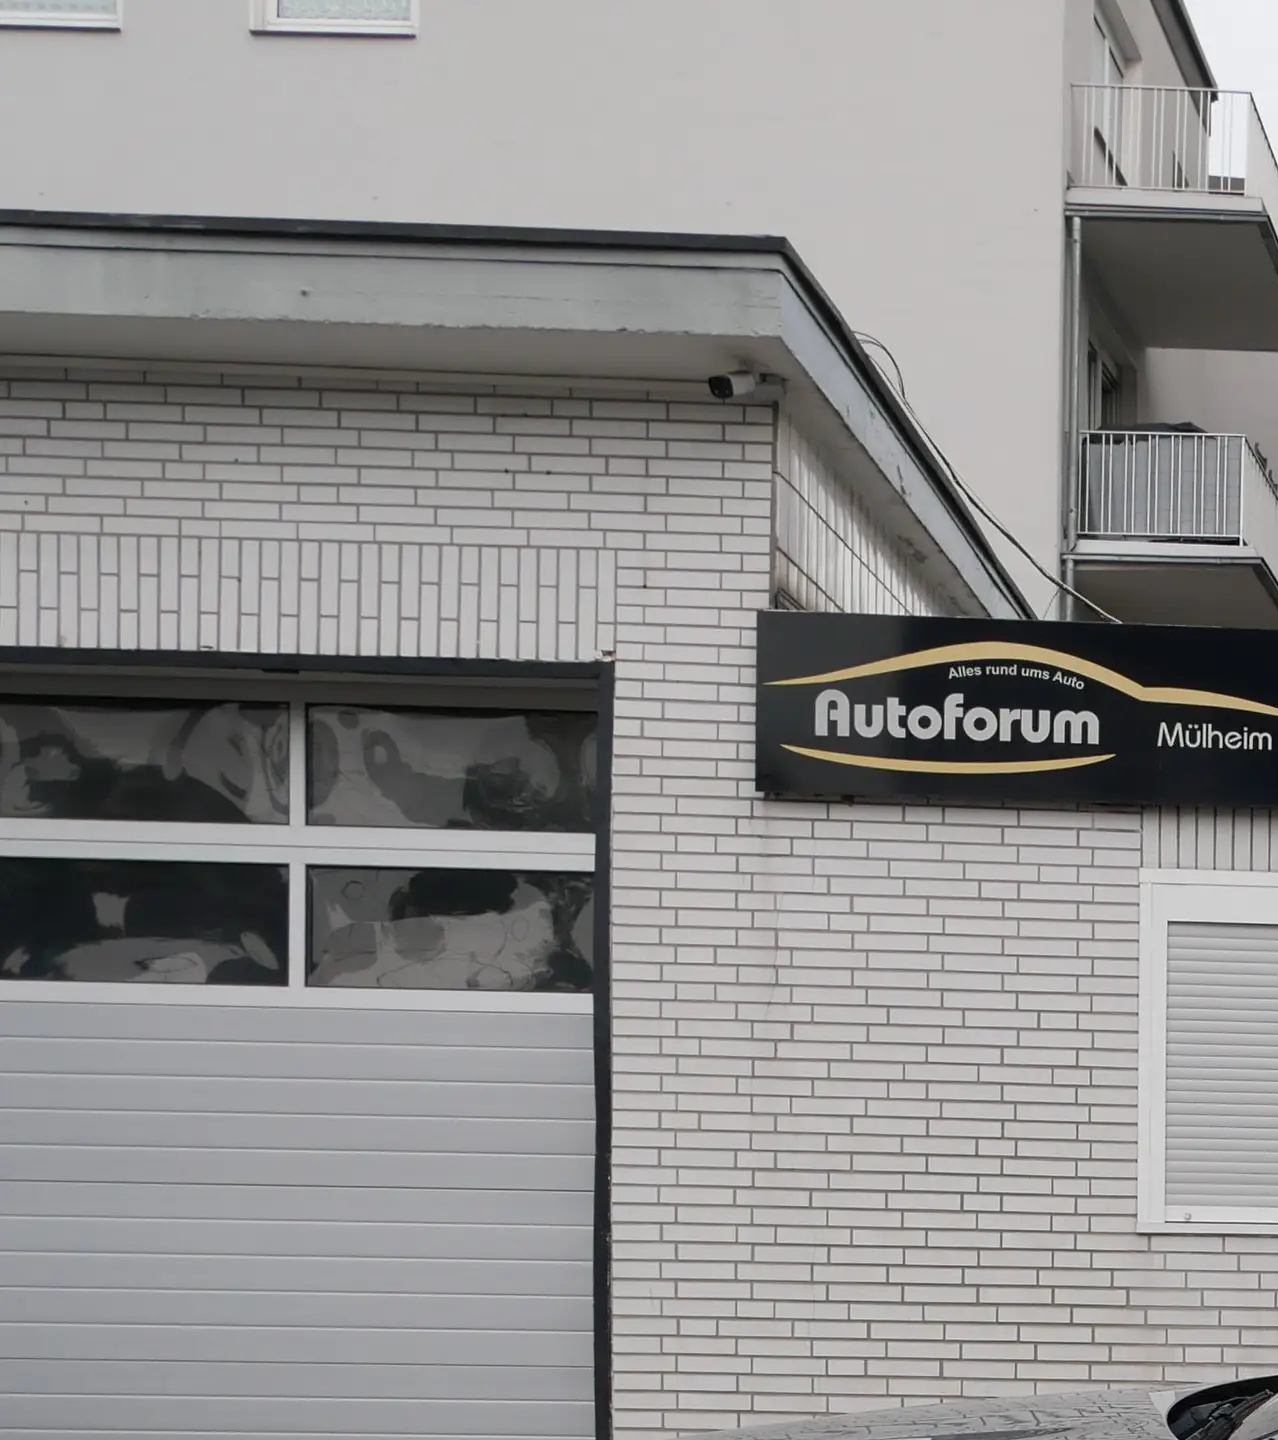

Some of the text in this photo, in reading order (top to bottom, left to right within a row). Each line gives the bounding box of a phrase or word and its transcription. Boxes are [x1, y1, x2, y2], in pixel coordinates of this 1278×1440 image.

[948, 664, 1085, 690] Alles rund ums Auto
[814, 688, 1100, 745] Autoforum
[1157, 721, 1273, 751] Mülheim
